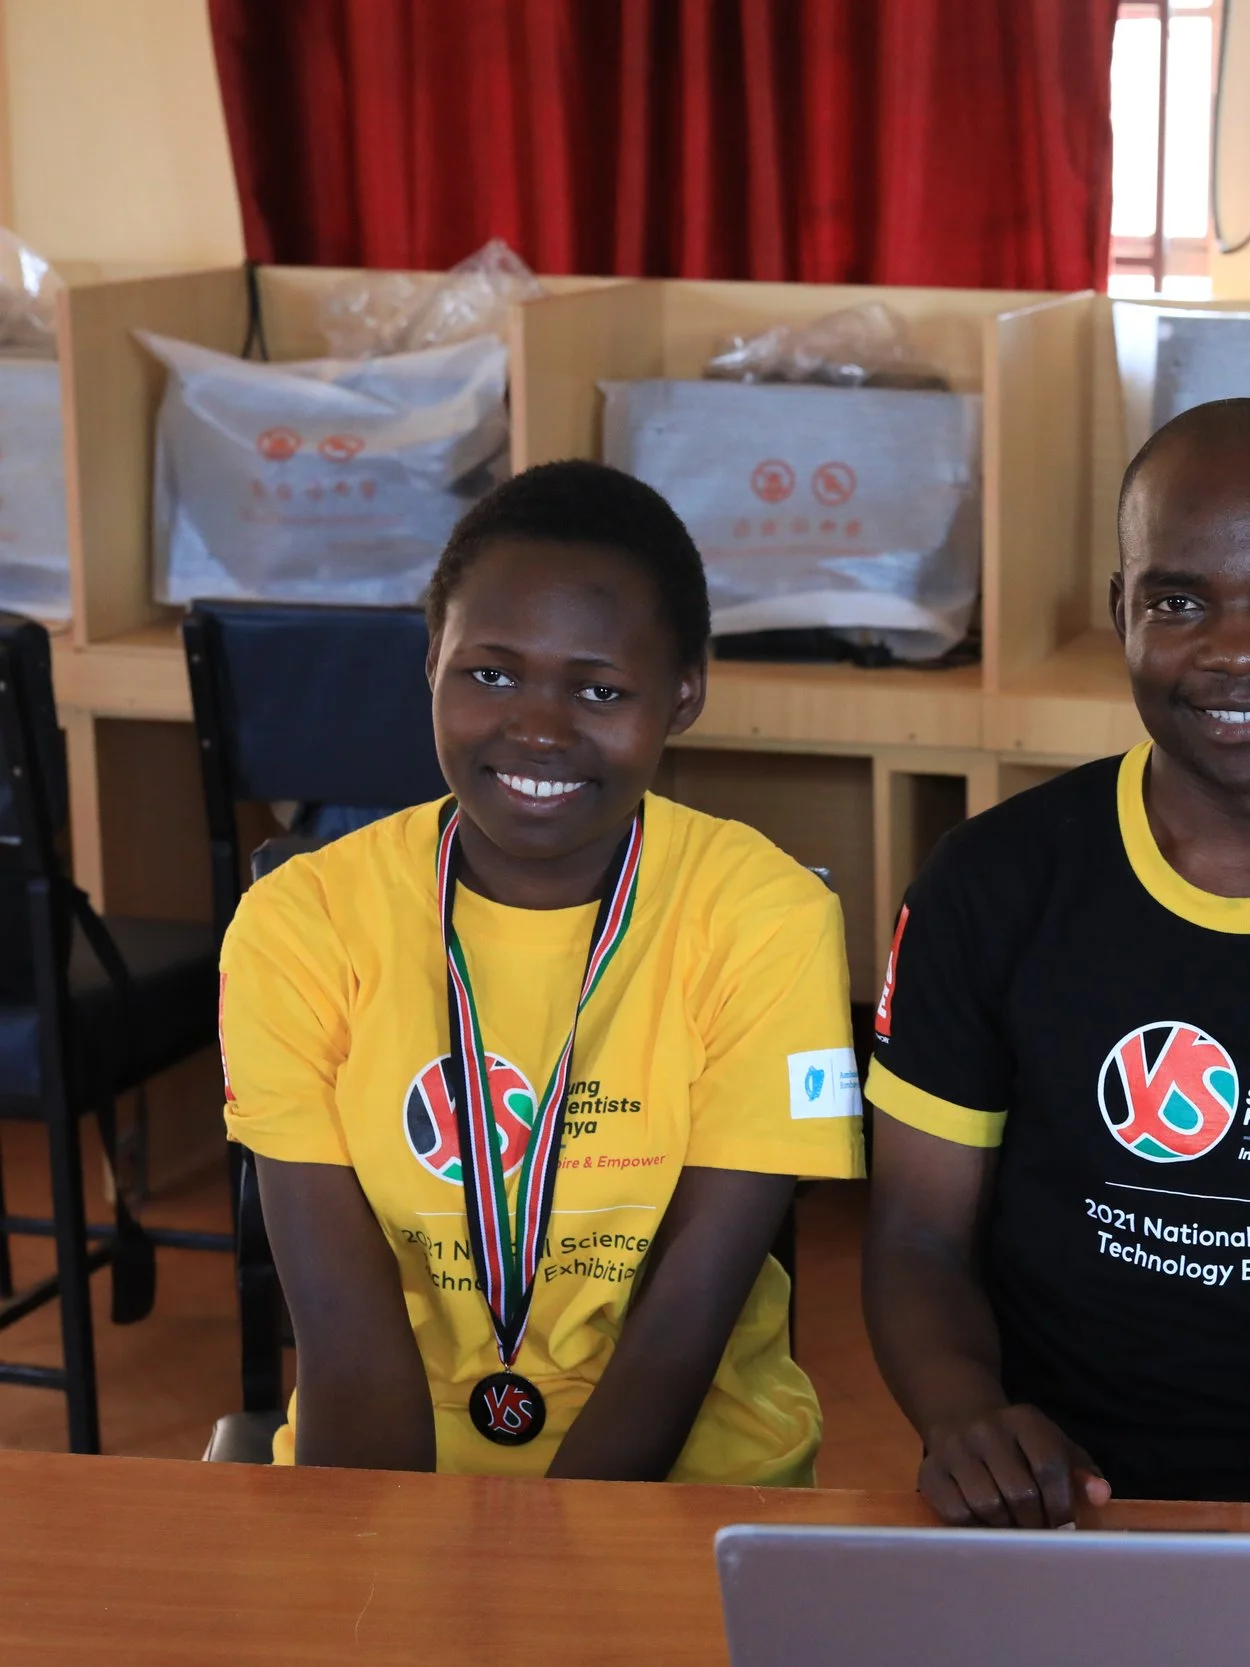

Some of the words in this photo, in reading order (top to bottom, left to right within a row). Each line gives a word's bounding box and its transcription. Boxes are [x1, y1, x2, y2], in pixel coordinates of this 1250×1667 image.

[567, 1080, 600, 1098] ung
[562, 1121, 597, 1139] nya
[583, 1156, 592, 1169] &
[597, 1155, 666, 1170] Empower
[1085, 1198, 1135, 1233] 2021
[561, 1231, 649, 1255] Science
[1097, 1230, 1234, 1286] Technology
